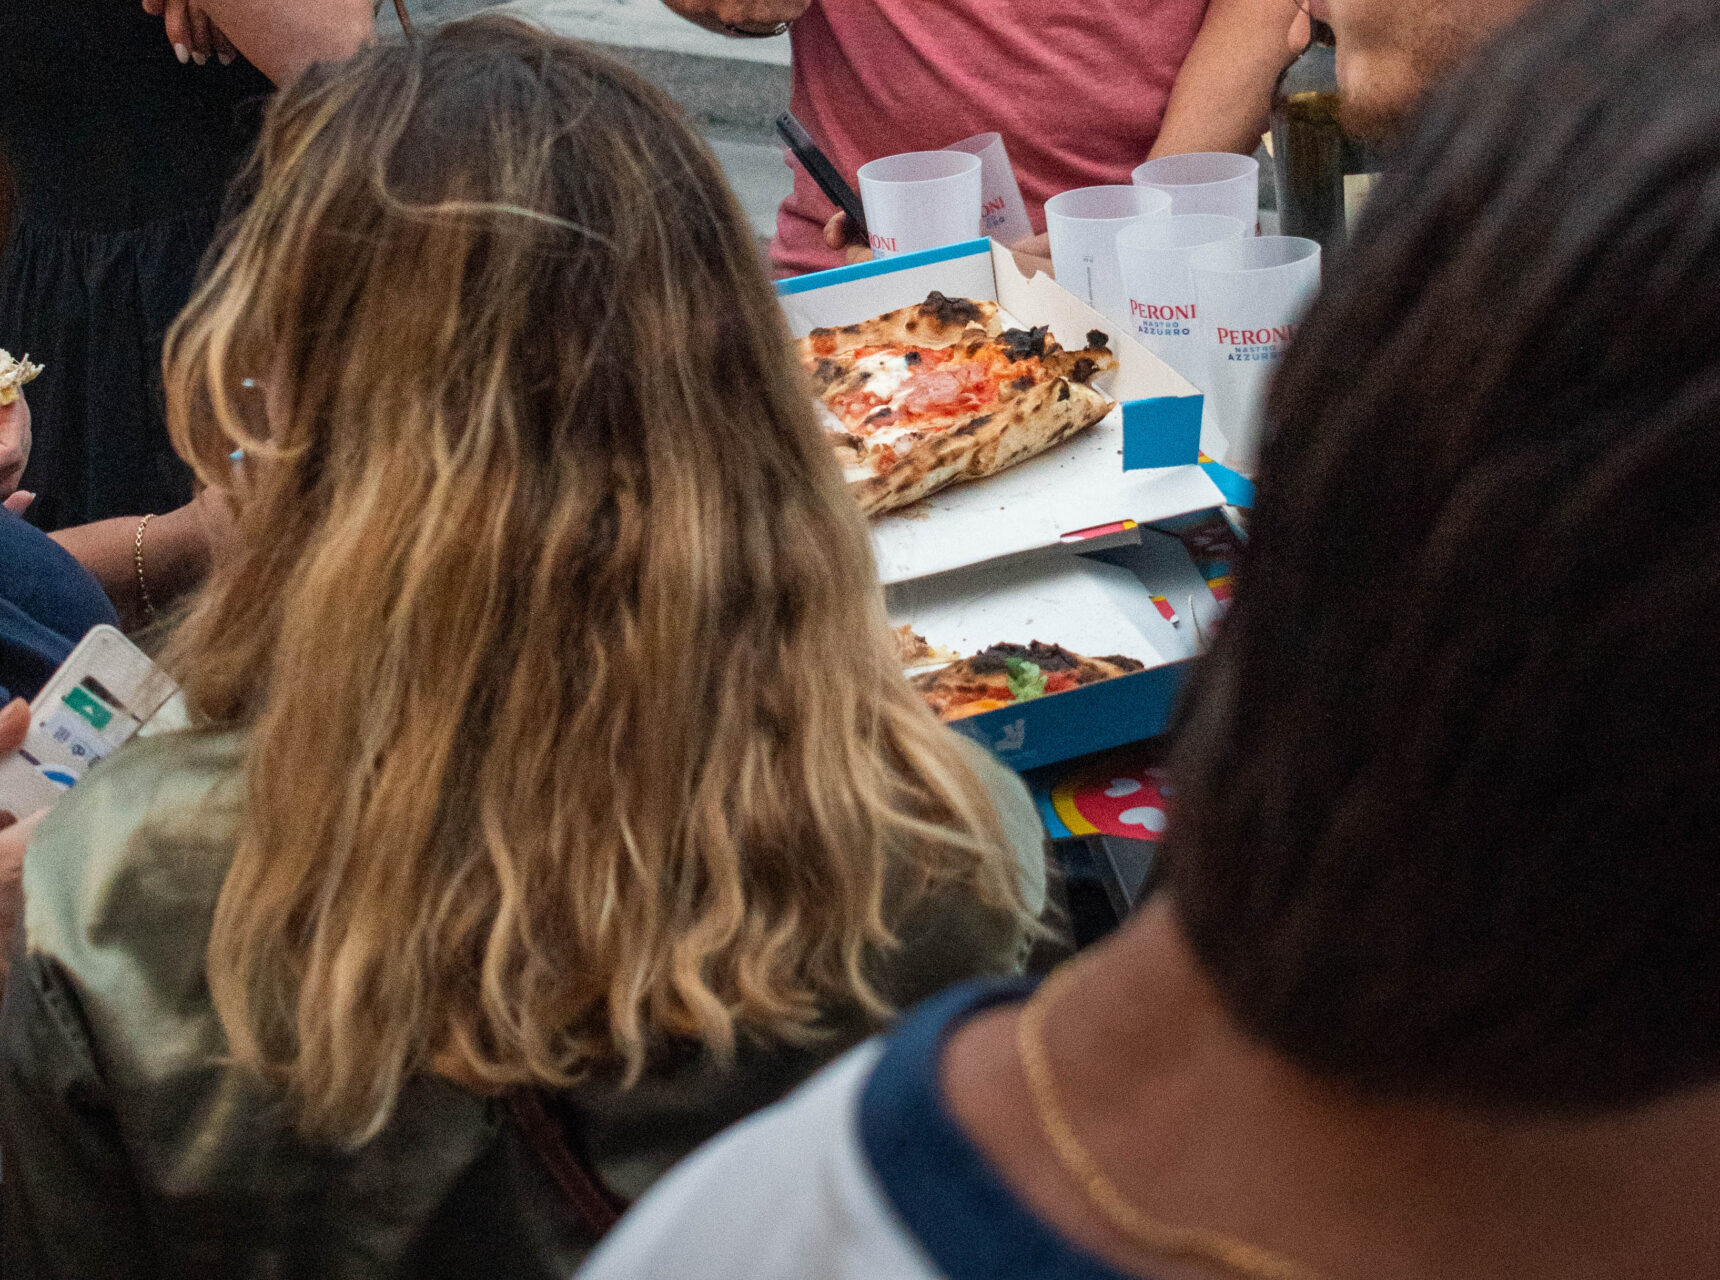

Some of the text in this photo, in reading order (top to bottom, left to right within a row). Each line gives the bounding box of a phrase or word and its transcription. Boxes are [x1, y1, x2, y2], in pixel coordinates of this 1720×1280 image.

[1129, 298, 1197, 321] PERONI
[1138, 325, 1190, 336] AZZURRO
[1142, 320, 1179, 328] NASTRO
[1216, 324, 1291, 346] PERON
